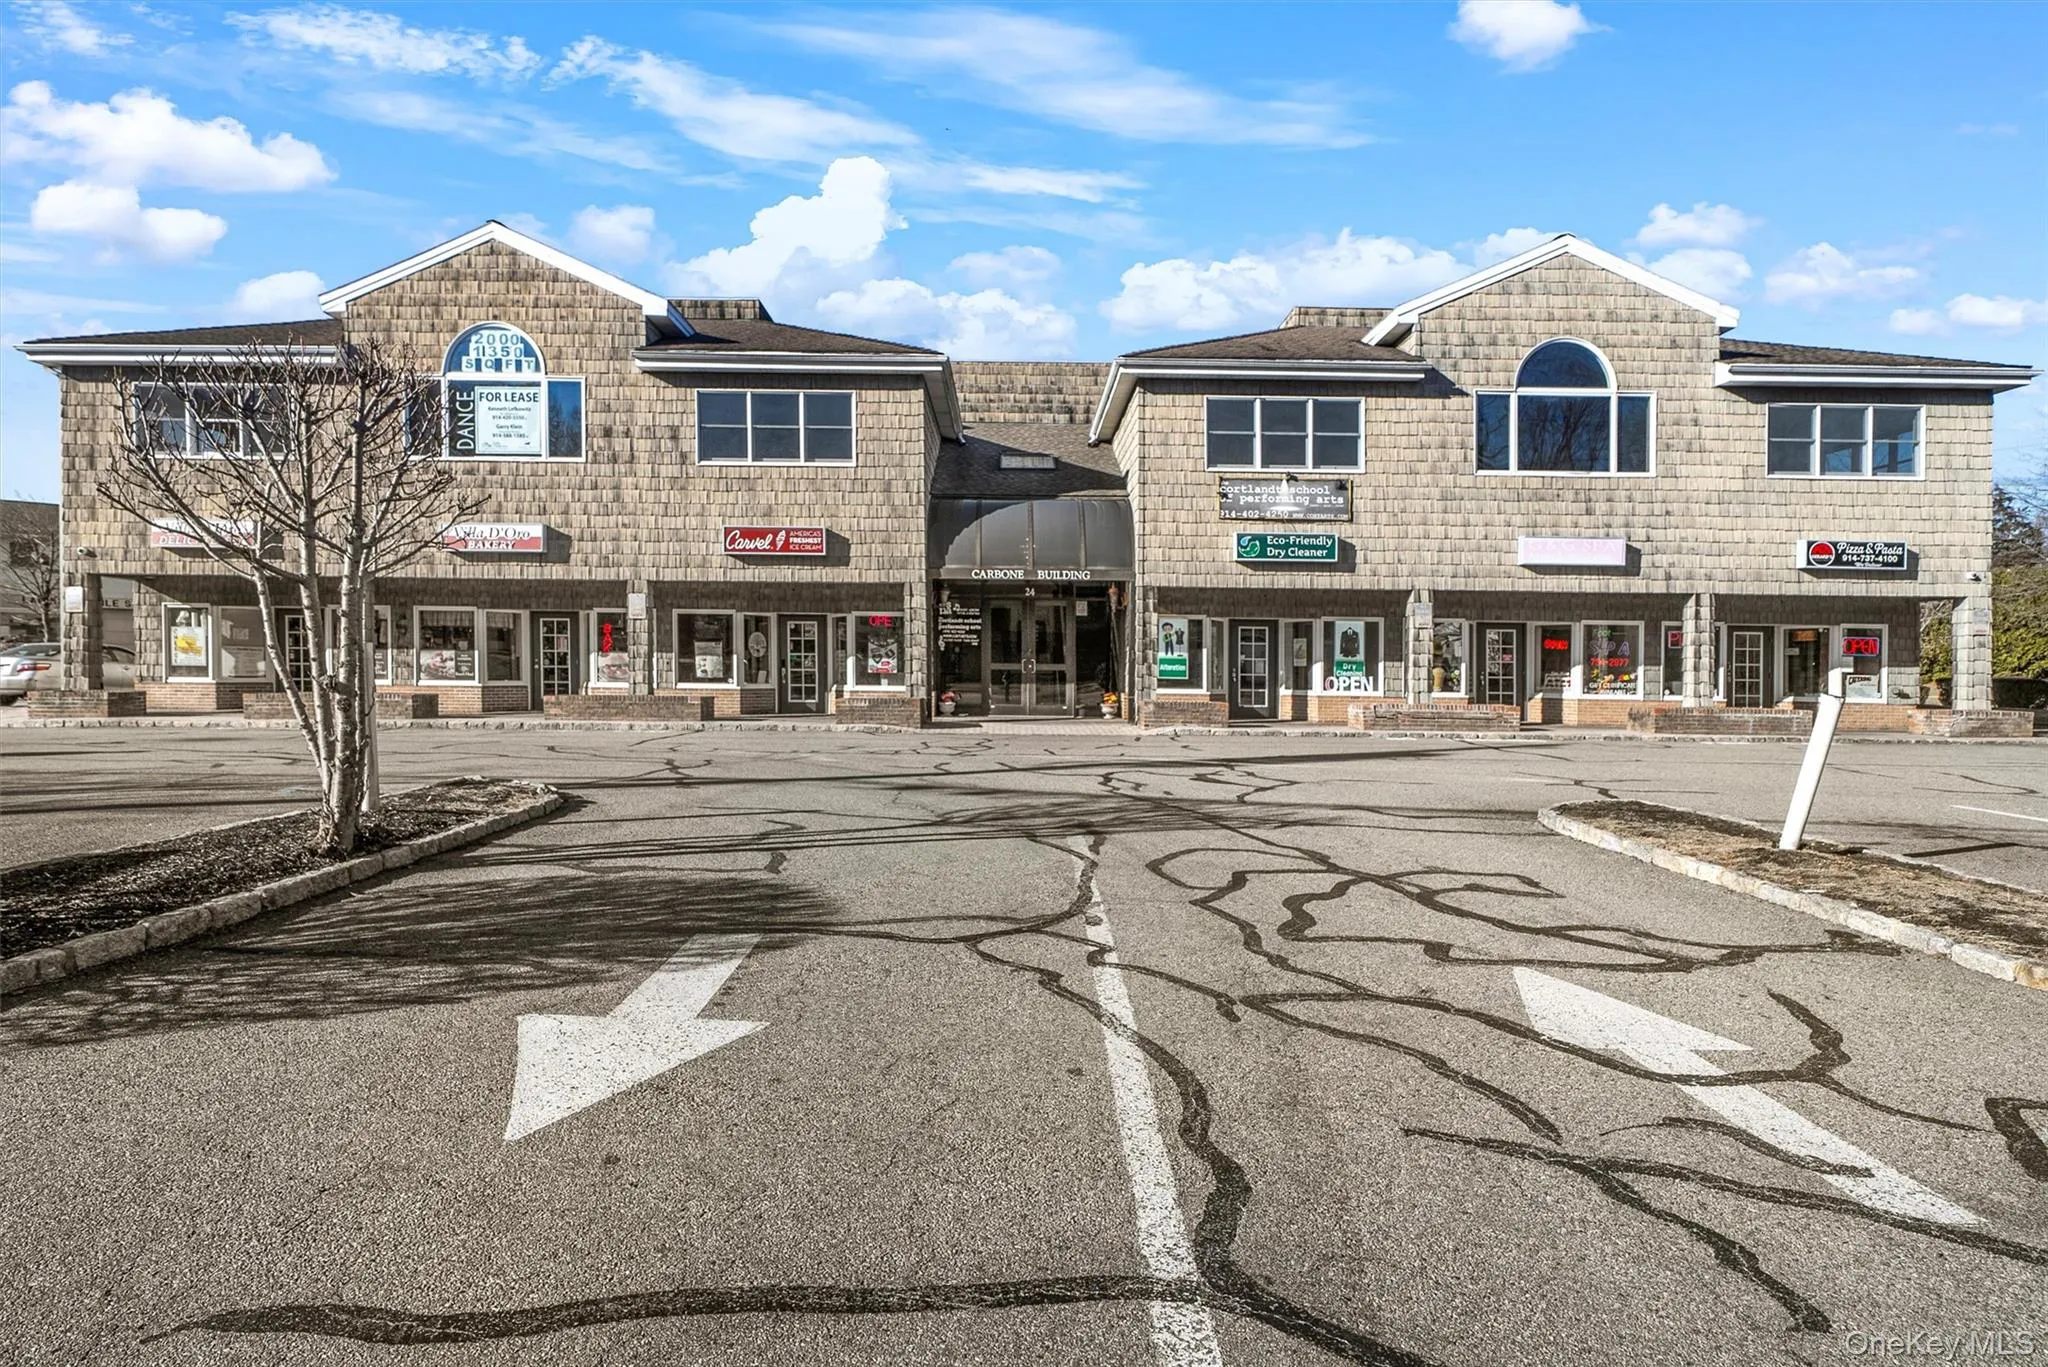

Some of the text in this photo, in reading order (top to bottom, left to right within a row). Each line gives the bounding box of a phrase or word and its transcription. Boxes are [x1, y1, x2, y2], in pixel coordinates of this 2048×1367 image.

[474, 333, 519, 345] 2000
[479, 392, 539, 403] FOR LEASE
[456, 391, 475, 450] DANCE
[1290, 485, 1331, 495] school
[1240, 494, 1310, 506] performing
[1316, 494, 1344, 504] arts
[489, 526, 531, 538] D'Oro
[467, 540, 516, 550] BAKERY
[726, 529, 773, 550] Carvel
[1266, 535, 1333, 547] Eco-Friendly
[1266, 548, 1328, 559] Dry Cleaner
[1836, 542, 1904, 555] Pizza & Pasta
[1842, 554, 1898, 563] 914-737-4100
[971, 569, 1091, 580] CARBONE BUILDING
[1024, 587, 1036, 597] 24
[1843, 639, 1879, 654] OPEN
[1342, 663, 1357, 671] Dry
[1324, 676, 1374, 692] OPEN
